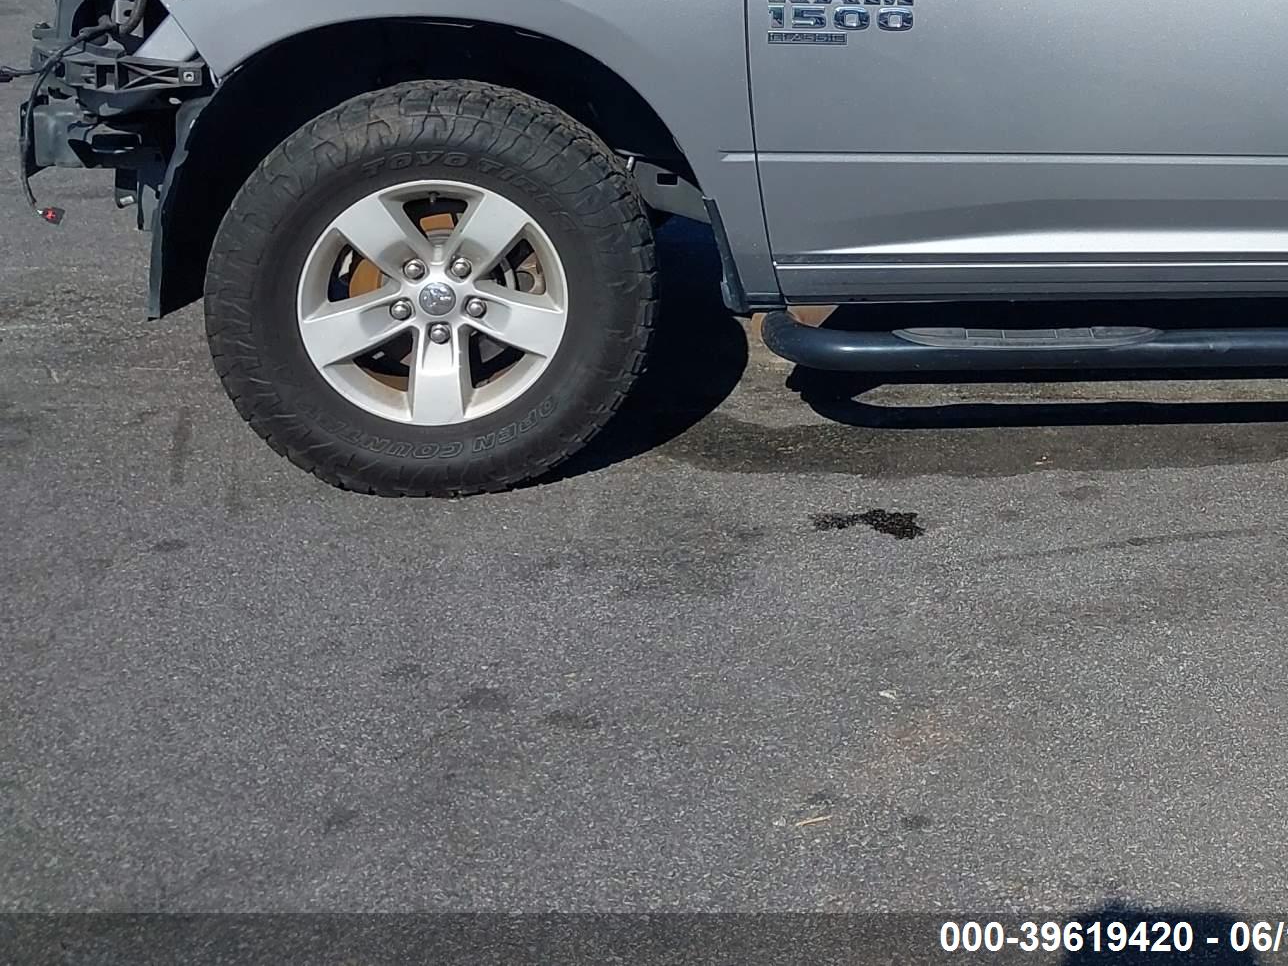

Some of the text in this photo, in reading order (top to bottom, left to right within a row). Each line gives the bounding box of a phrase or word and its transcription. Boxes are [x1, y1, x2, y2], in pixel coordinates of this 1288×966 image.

[767, 5, 914, 32] 1500
[361, 150, 470, 178] TOYO
[472, 395, 557, 452] OPEN
